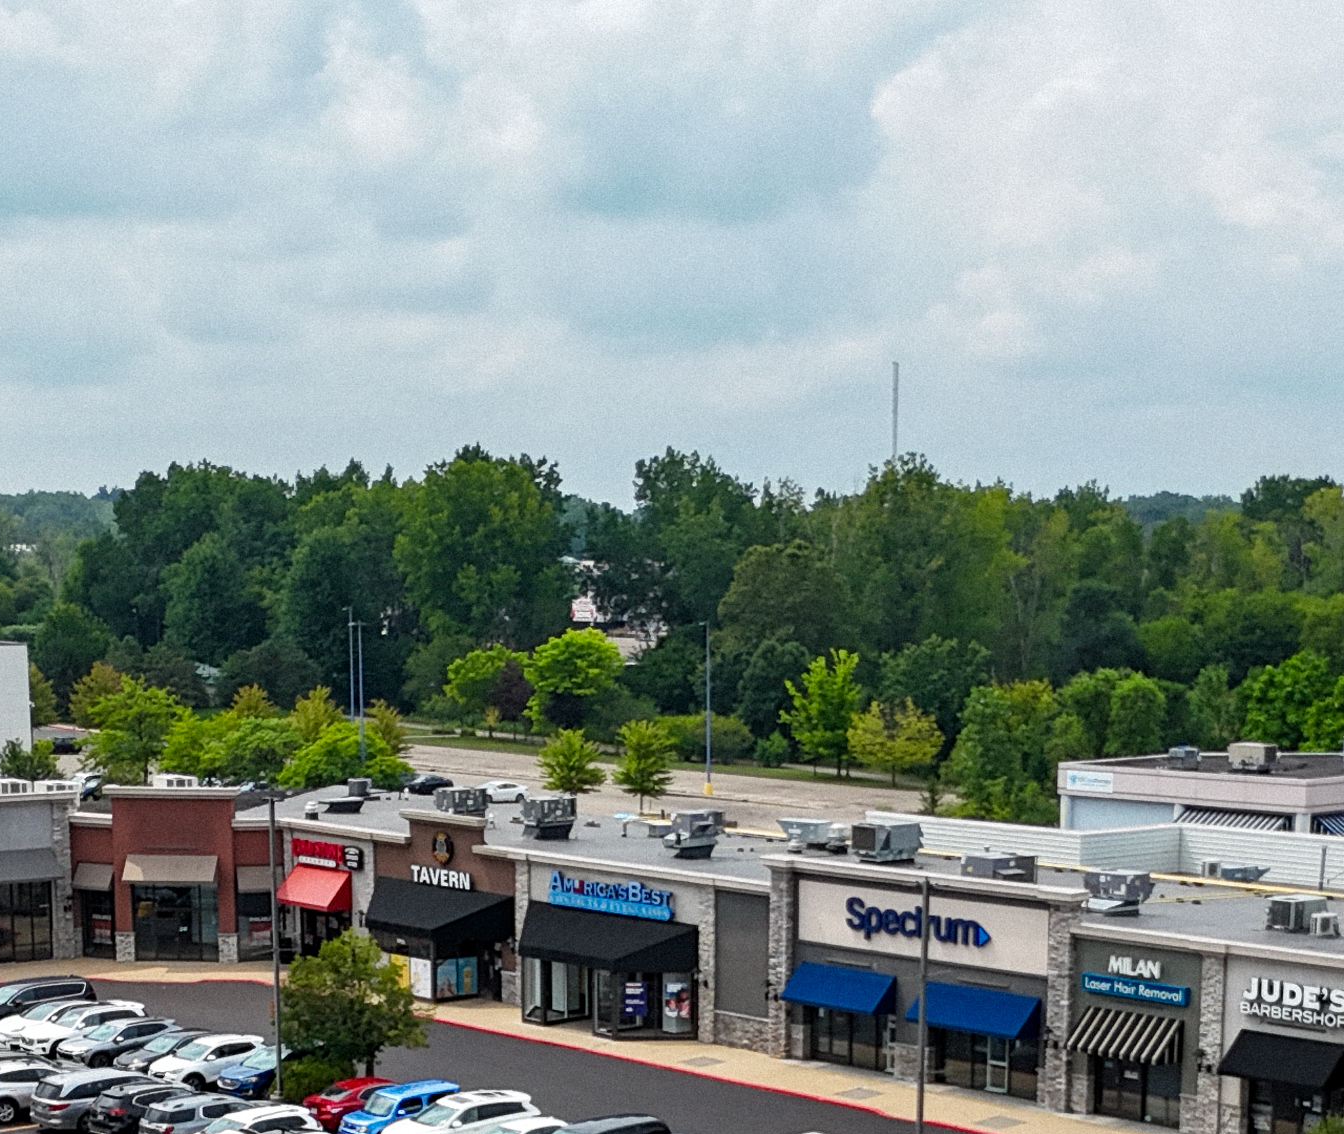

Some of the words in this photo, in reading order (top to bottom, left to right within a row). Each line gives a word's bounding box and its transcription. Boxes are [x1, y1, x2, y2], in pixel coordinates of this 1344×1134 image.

[410, 864, 471, 891] TAVERN
[627, 881, 673, 907] BEST
[1108, 955, 1162, 980] MILAN
[1085, 977, 1111, 991] Laser
[1113, 981, 1136, 995] Hair
[1138, 985, 1182, 1002] Removal
